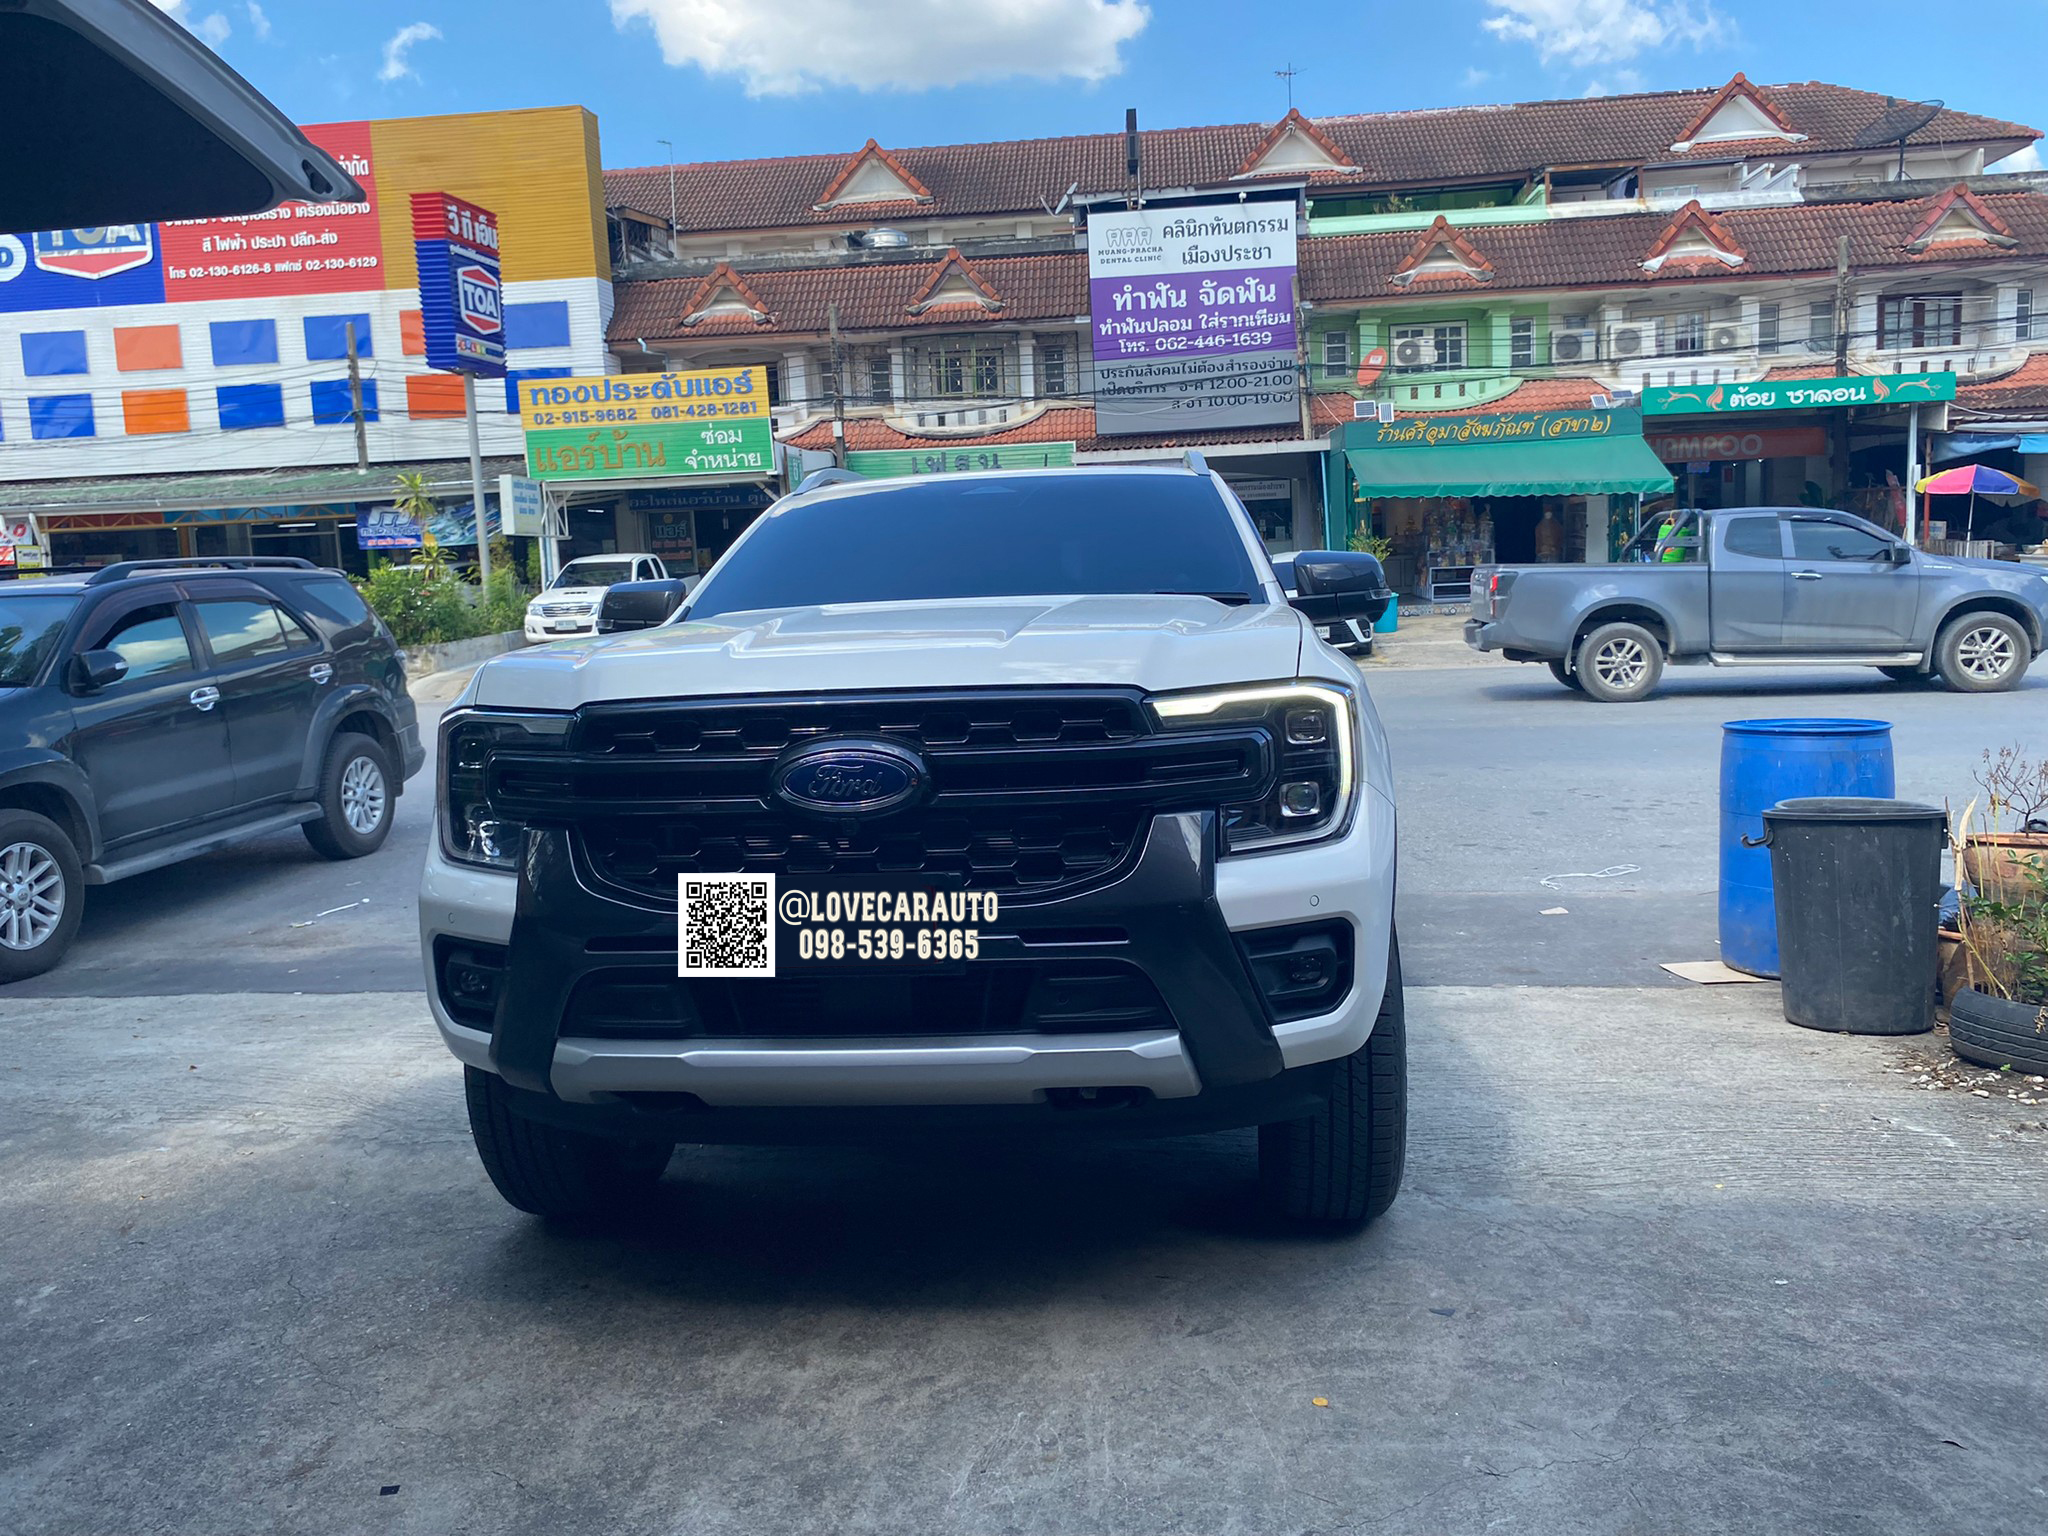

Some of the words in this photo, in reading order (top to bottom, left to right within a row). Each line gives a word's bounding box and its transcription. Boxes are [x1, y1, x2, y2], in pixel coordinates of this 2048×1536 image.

[1162, 216, 1289, 240] คลินิกทันตกรรม
[202, 236, 213, 253] สี
[216, 233, 247, 251] ไฟฟ้า
[251, 232, 286, 251] ประปา
[290, 229, 338, 246] ปลีก-ส่ง
[1098, 246, 1164, 256] MUANG-PRACHA
[1134, 255, 1162, 263] CLINIC
[1182, 245, 1272, 266] เมืองประชา
[189, 263, 271, 279] 02-130-6126-8
[306, 256, 378, 272] 02-130-6129
[464, 282, 498, 318] TOA
[1112, 282, 1187, 312] ทำฟัน
[1199, 277, 1277, 306] จัดฟัน
[1099, 316, 1193, 336] ทำฟันปลอม
[1199, 309, 1291, 329] ใส่รากเทียม
[1118, 338, 1150, 353] โทร.
[1155, 331, 1272, 351] 062-446-1639
[1101, 357, 1293, 380] ประกันสังคมไม่ต้องสำรองจ่าย
[529, 369, 754, 406] ทองประดับแอร์
[1210, 374, 1293, 391] 12.00-21.00
[1208, 391, 1293, 408] 10.00-19.00
[1729, 385, 1776, 408] ต้อย
[1786, 386, 1867, 405] ซาลอน
[533, 408, 638, 426] 02-915-9682
[650, 400, 758, 419] 081-428-1281
[700, 423, 743, 445] ซ่อม
[1541, 414, 1612, 438] (สาขา๒)
[534, 429, 667, 472] แอร์บ้าน
[1646, 434, 1763, 460] HAMPOO
[684, 448, 762, 470] จำหน่าย
[808, 764, 884, 796] Ford
